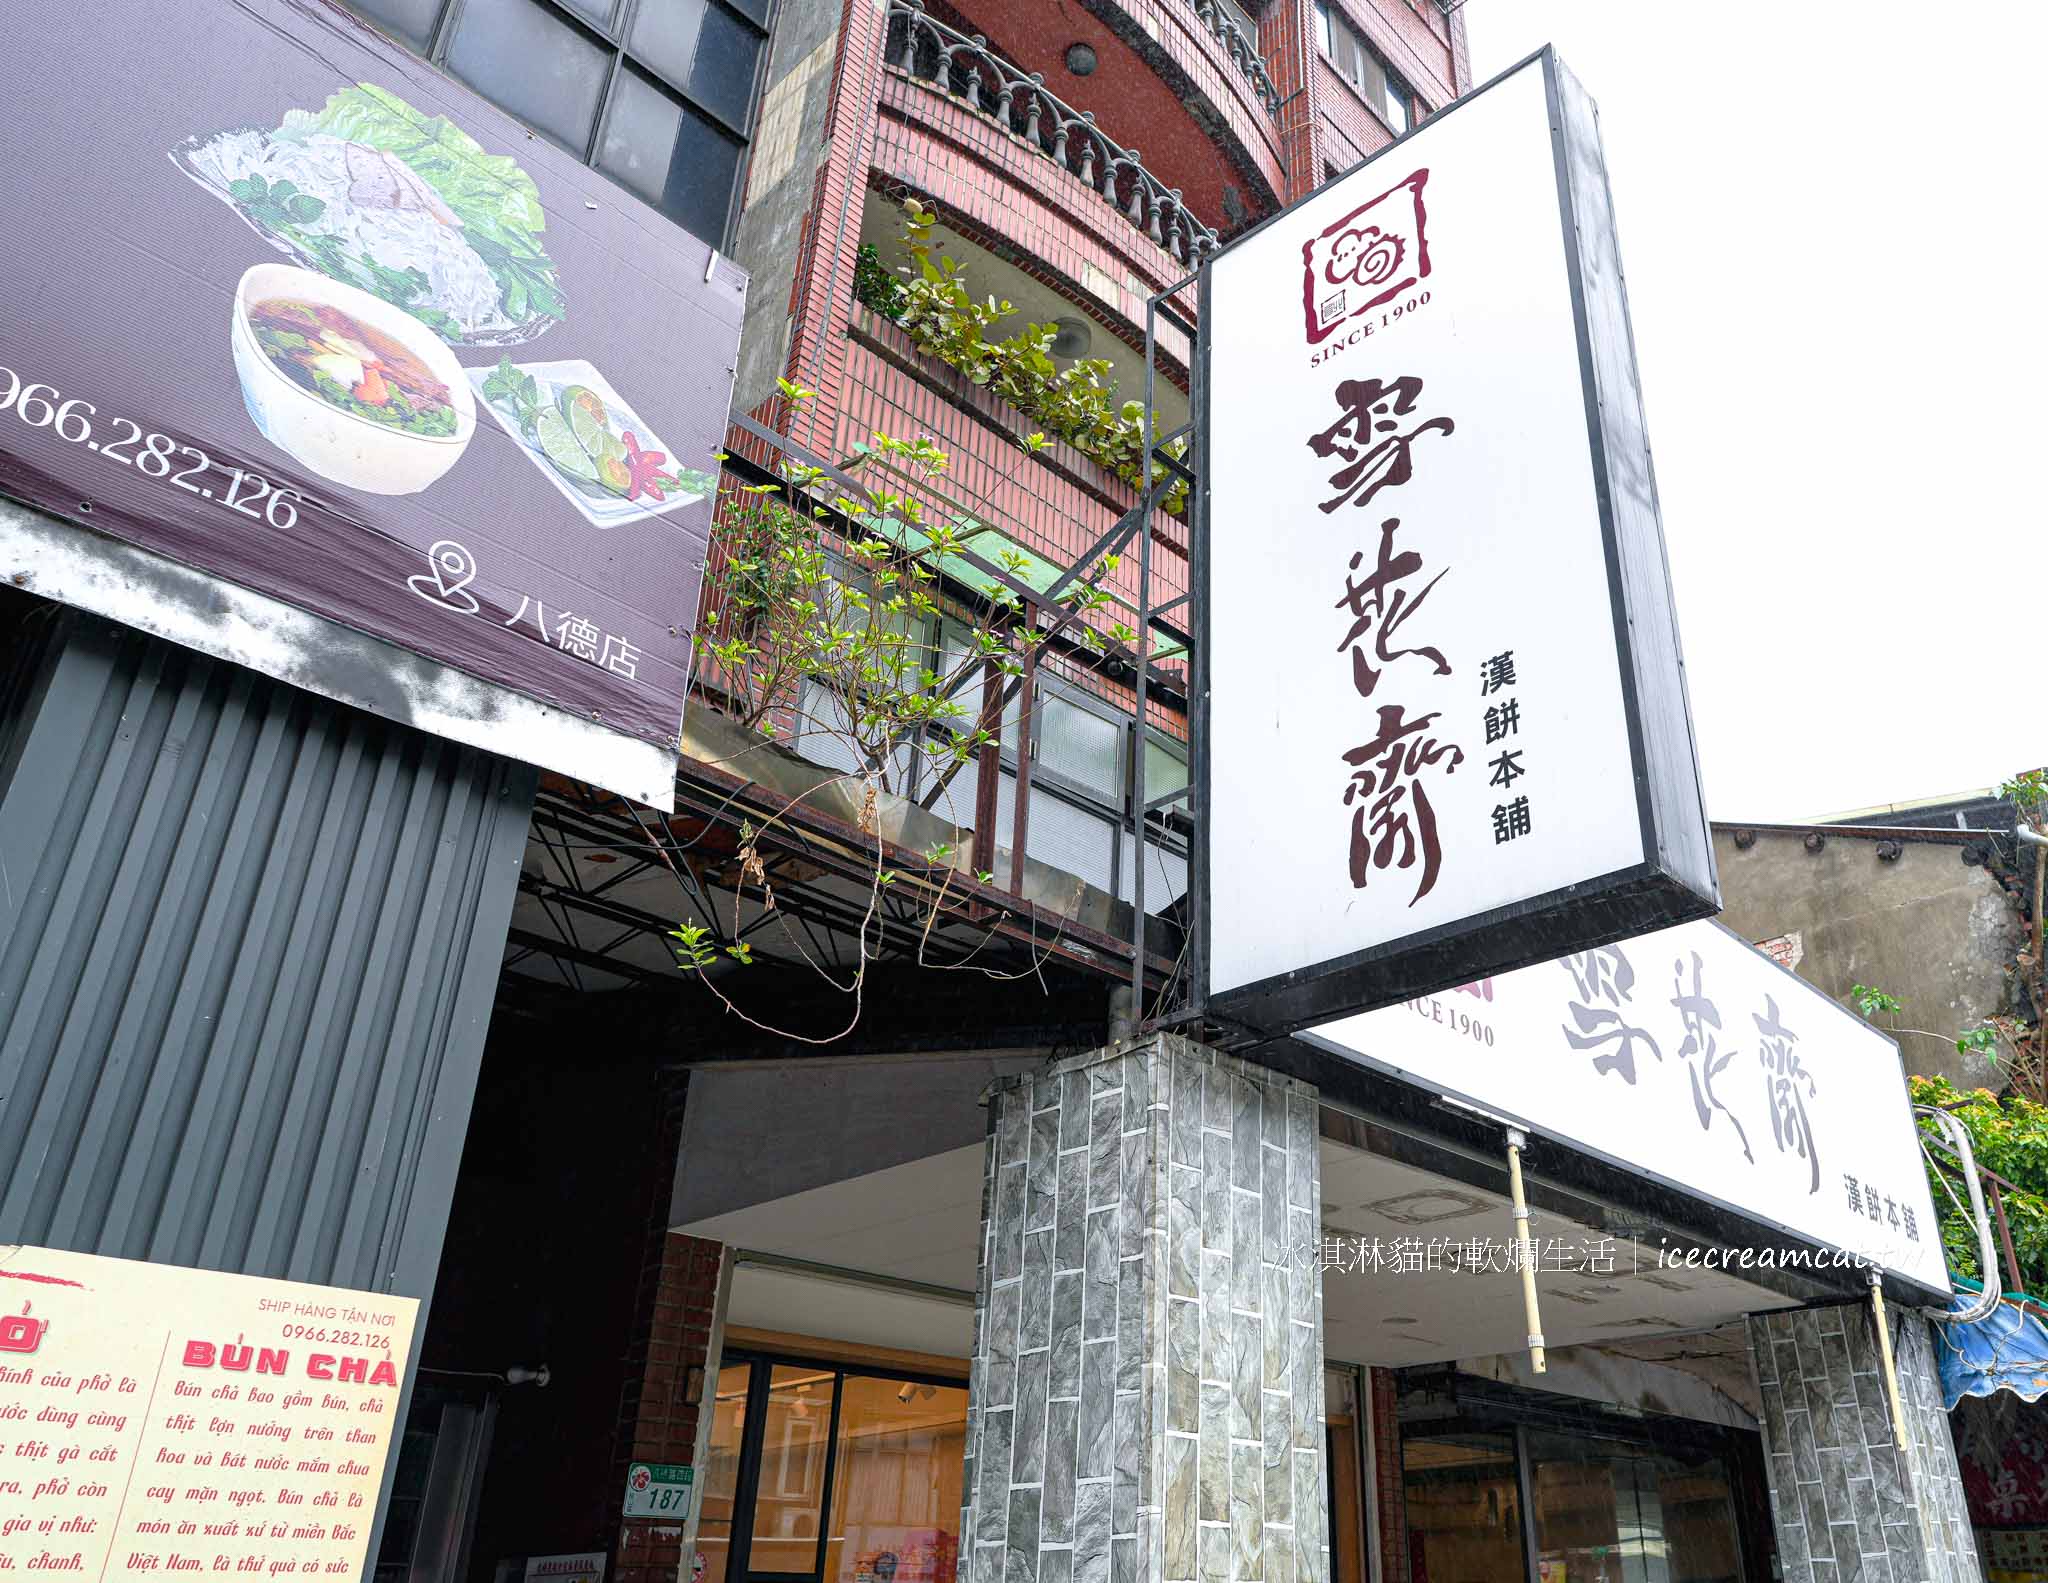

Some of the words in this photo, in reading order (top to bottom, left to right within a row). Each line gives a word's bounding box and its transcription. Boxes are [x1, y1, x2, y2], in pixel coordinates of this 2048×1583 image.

[1310, 321, 1375, 368] SINCE
[1381, 291, 1432, 329] 1900
[505, 595, 642, 680] 八德店
[1450, 1008, 1494, 1047] 1900
[258, 1298, 291, 1313] SHIP
[295, 1302, 337, 1319] HÀNG
[282, 1324, 390, 1349] 0966.282.126
[182, 1333, 290, 1375] BÚN
[306, 1350, 398, 1387] CHẢ
[41, 1371, 72, 1387] của
[76, 1373, 112, 1394] phở
[118, 1377, 137, 1392] là
[174, 1380, 202, 1397] Bún
[211, 1384, 239, 1400] chả
[247, 1387, 274, 1403] bao
[282, 1390, 313, 1409] gồm
[36, 1406, 79, 1429] dùng
[87, 1411, 127, 1432] cùng
[165, 1414, 195, 1434] thịt
[208, 1416, 235, 1437] lợn
[247, 1420, 291, 1442] nướng
[304, 1425, 333, 1441] trên
[345, 1428, 376, 1444] than
[16, 1440, 48, 1461] thịt
[57, 1444, 80, 1464] gà
[89, 1444, 118, 1461] cắt
[155, 1447, 184, 1464] hoa
[194, 1451, 213, 1466] và
[254, 1454, 290, 1471] nước
[296, 1457, 330, 1473] mắm
[337, 1459, 370, 1476] chua
[32, 1477, 70, 1500] phở
[77, 1481, 107, 1496] còn
[146, 1486, 175, 1504] cay
[185, 1485, 218, 1504] mặn
[277, 1488, 304, 1505] Bún
[312, 1491, 338, 1507] chả
[347, 1492, 362, 1508] là
[649, 1488, 685, 1511] 187
[2, 1514, 32, 1536] gia
[38, 1515, 56, 1536] vị
[136, 1518, 171, 1534] món
[177, 1520, 197, 1535] ăn
[203, 1519, 239, 1537] xuất
[245, 1522, 266, 1537] xứ
[270, 1522, 288, 1538] từ
[291, 1523, 325, 1539] miền
[331, 1524, 356, 1540] Bắc
[127, 1552, 160, 1574] Việt
[212, 1554, 230, 1571] là
[236, 1554, 264, 1572] thứ
[269, 1557, 297, 1576] quà
[302, 1557, 319, 1573] có
[325, 1556, 349, 1574] sức
